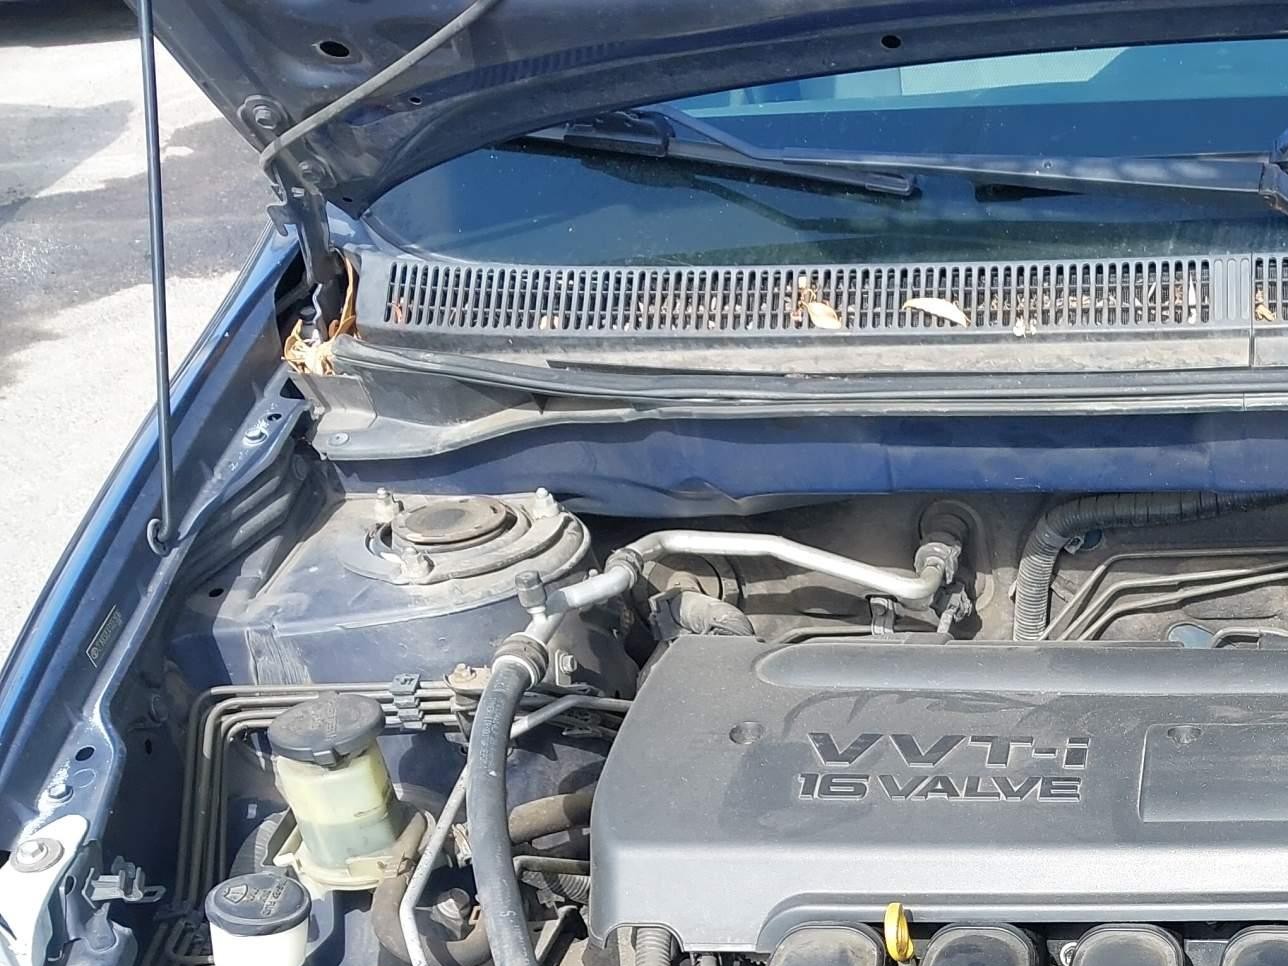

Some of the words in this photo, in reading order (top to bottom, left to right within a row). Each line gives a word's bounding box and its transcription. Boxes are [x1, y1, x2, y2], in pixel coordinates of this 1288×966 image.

[807, 732, 1091, 769] VVT-i
[798, 773, 871, 800] 16
[877, 774, 1082, 803] VALVE
